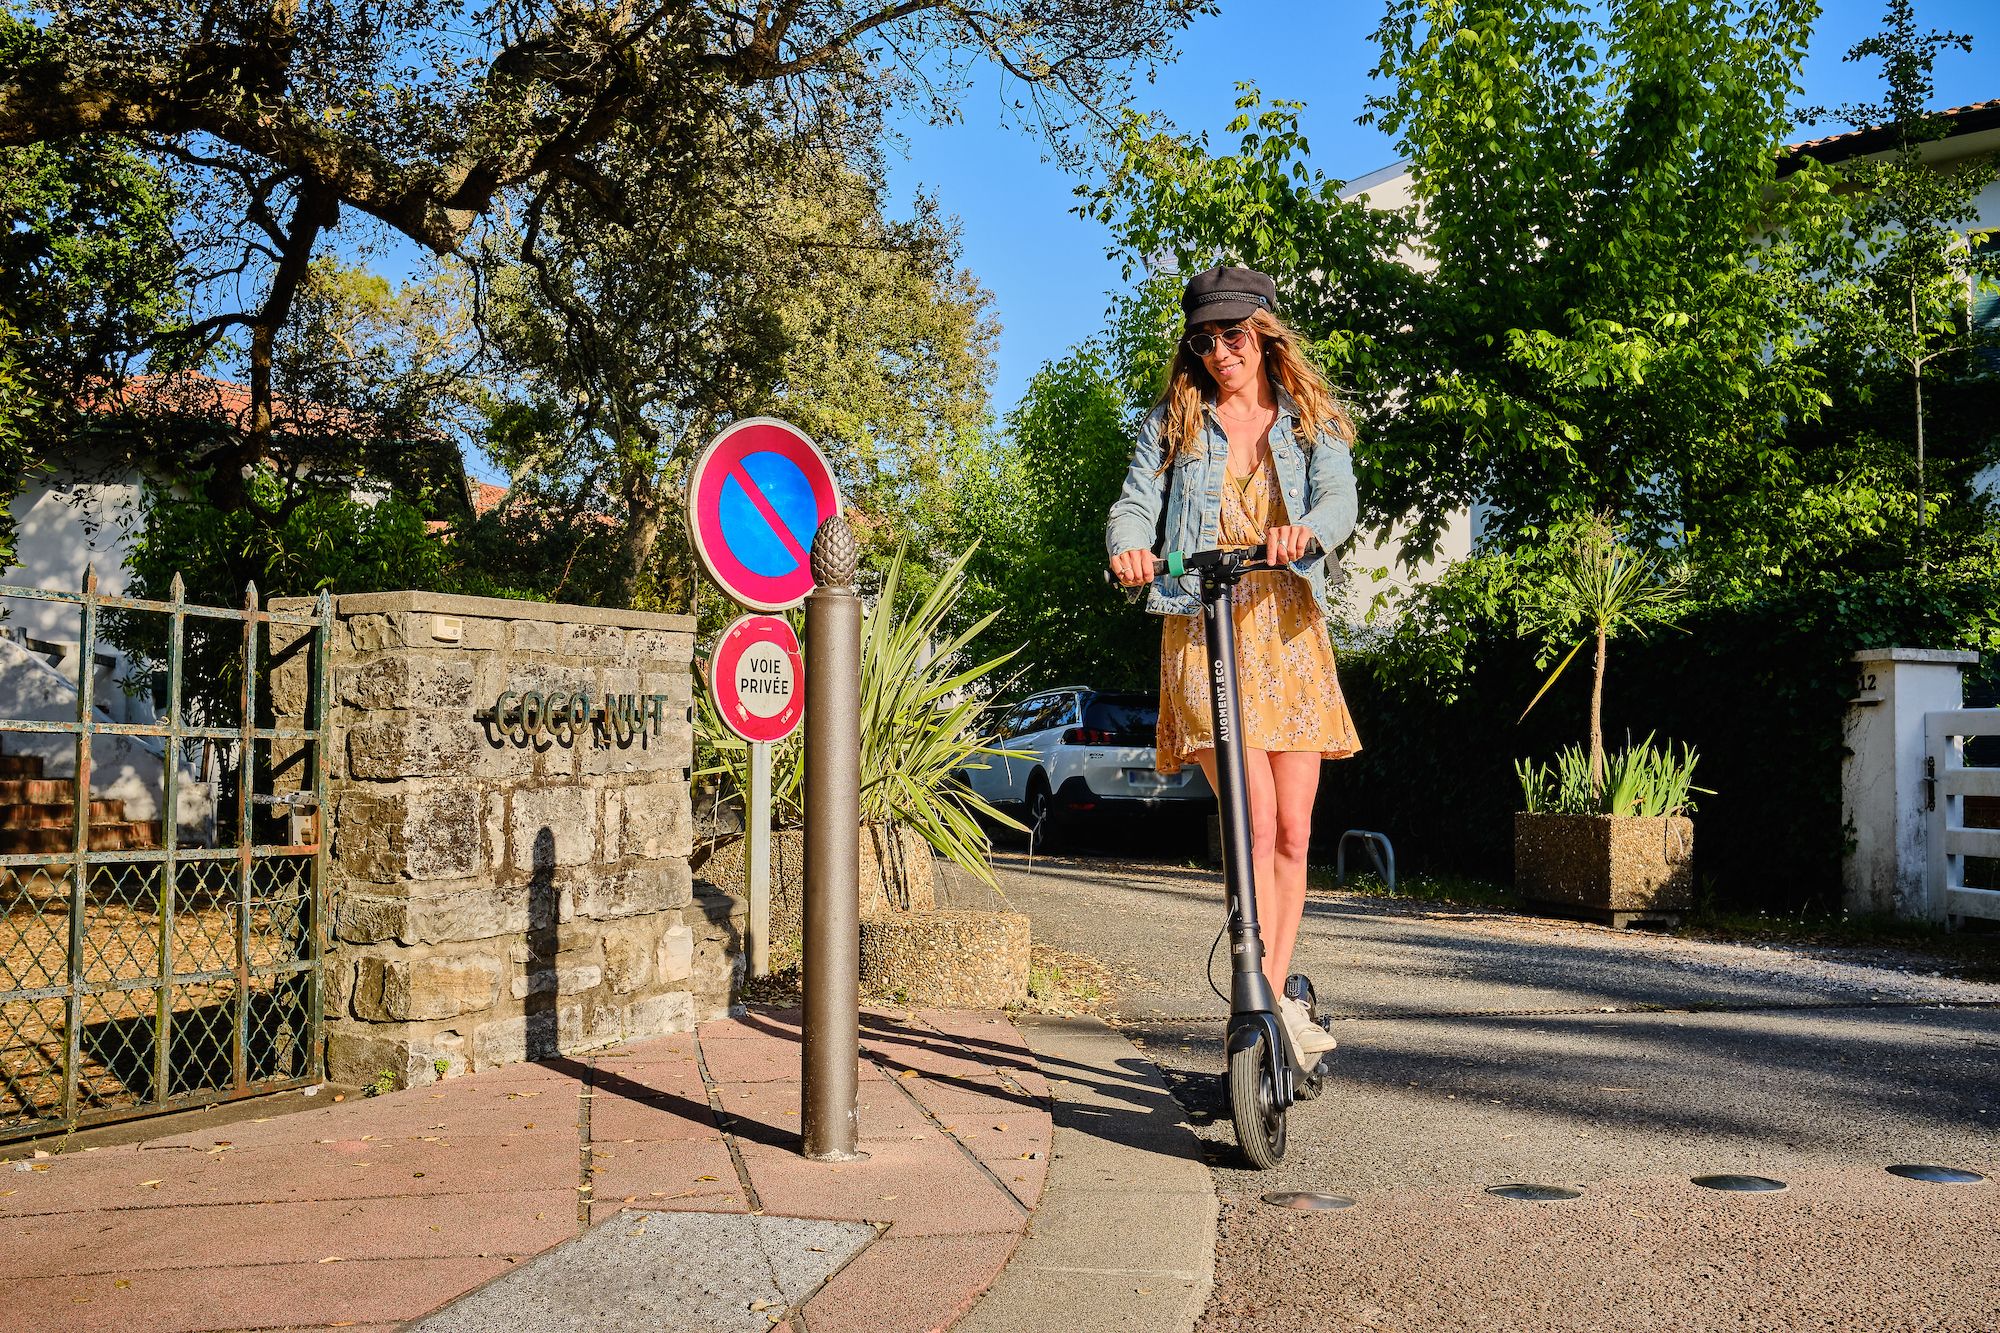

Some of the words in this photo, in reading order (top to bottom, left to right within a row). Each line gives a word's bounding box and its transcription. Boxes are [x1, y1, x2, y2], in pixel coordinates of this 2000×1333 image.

[750, 658, 781, 674] VOIE
[740, 676, 789, 695] PRIVÉE
[1859, 674, 1877, 690] 12
[1214, 659, 1230, 742] AUGMENT.ECO
[496, 690, 590, 736] COCO
[605, 693, 668, 736] NUT
